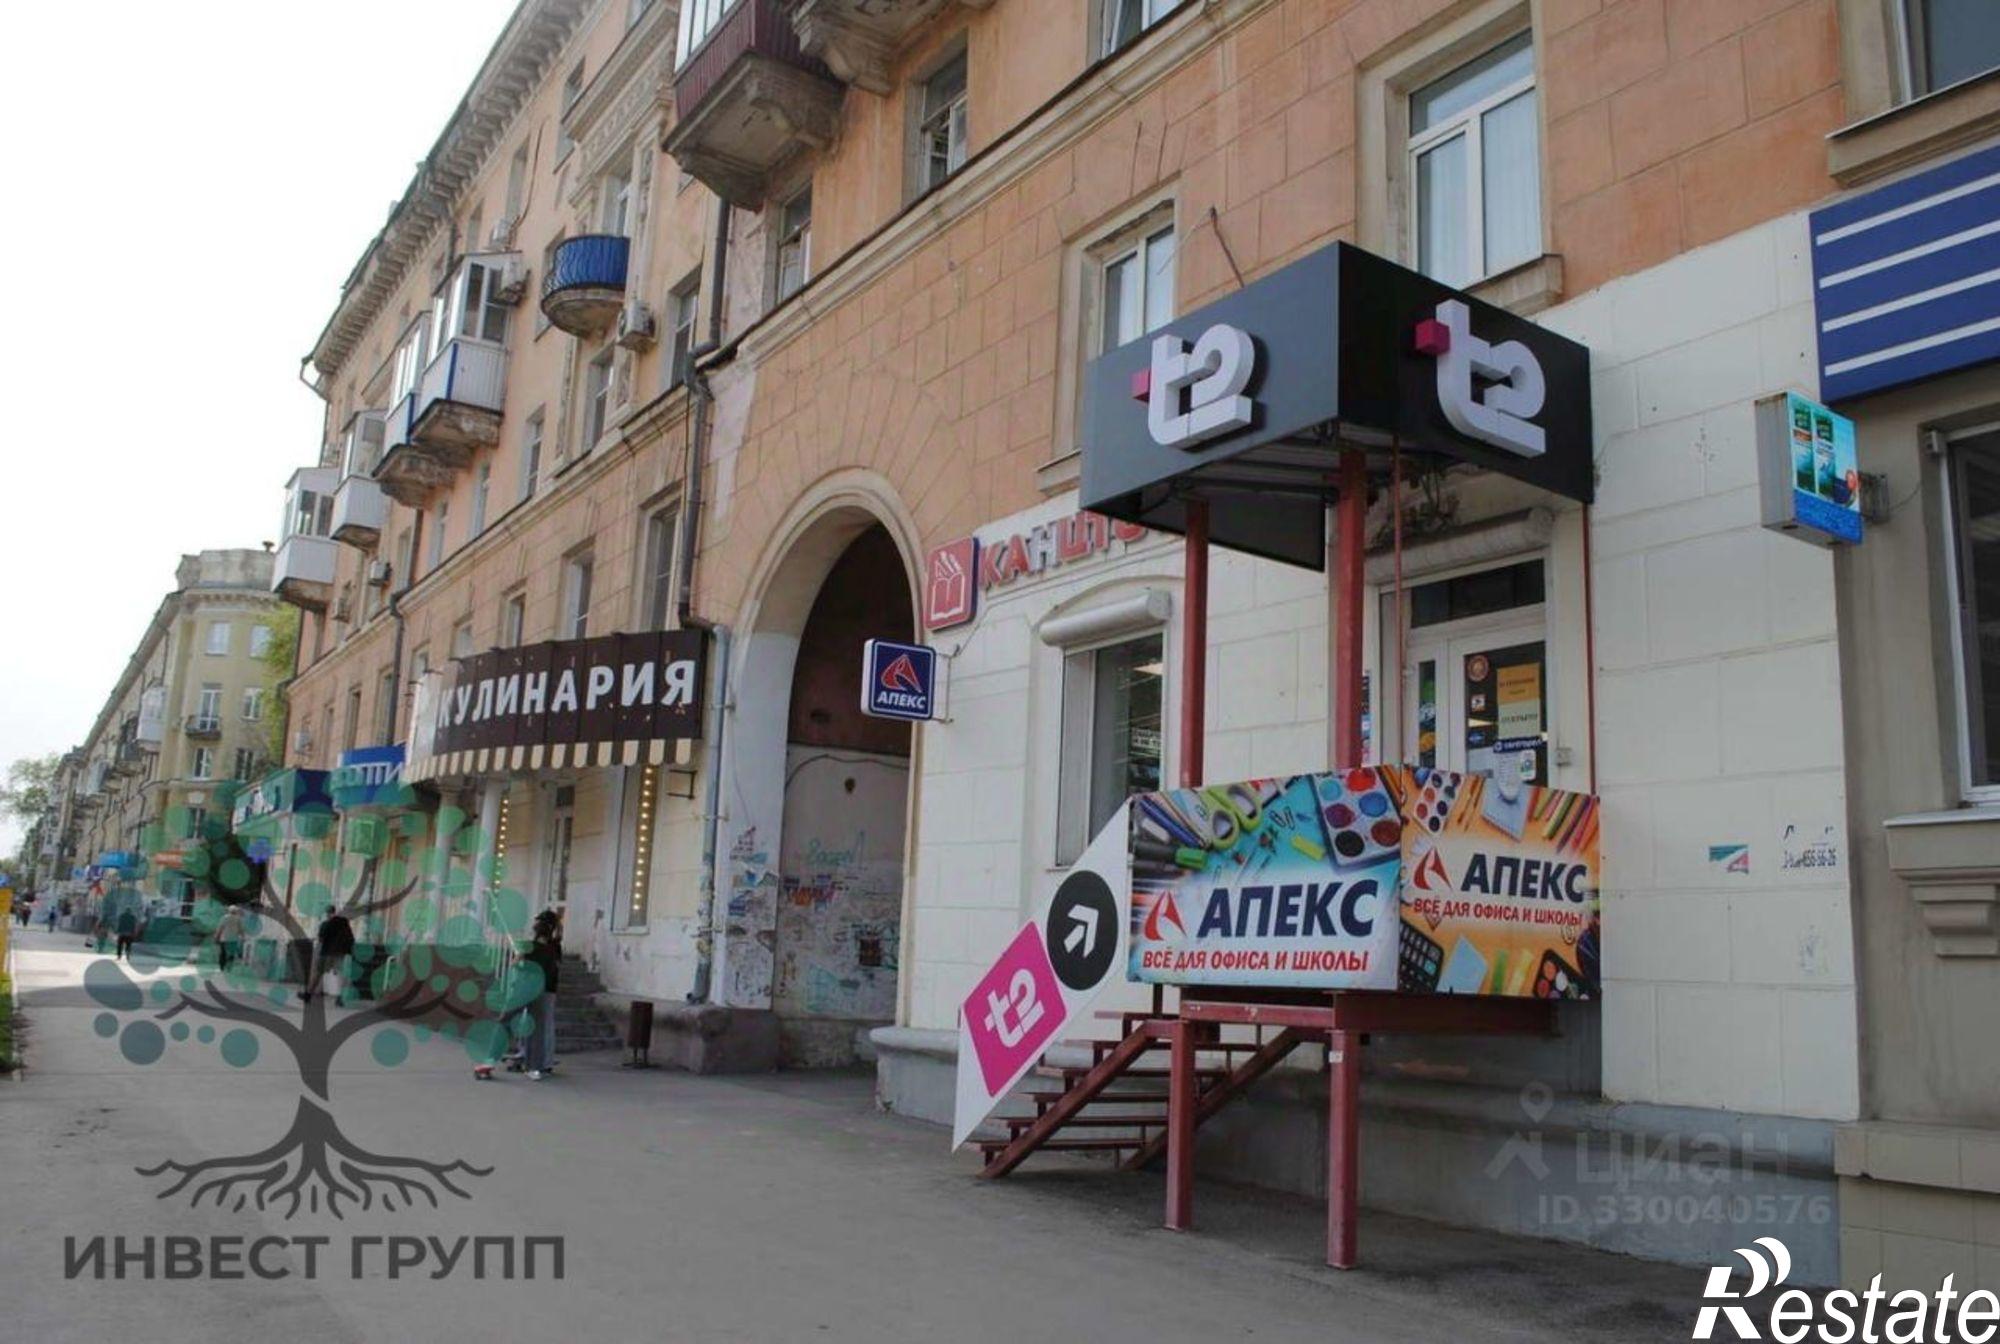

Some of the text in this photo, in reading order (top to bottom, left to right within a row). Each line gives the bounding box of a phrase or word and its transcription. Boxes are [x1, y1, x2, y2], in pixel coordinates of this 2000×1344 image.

[1131, 323, 1255, 447] t2
[1414, 299, 1547, 458] t2
[437, 659, 696, 729] КУЛИНАРИЯ
[877, 690, 926, 709] АПЕКС
[1459, 852, 1588, 904] АПЕКС
[1196, 879, 1379, 938] АПЕКС
[1443, 899, 1470, 917] ДЛЯ
[1473, 902, 1520, 922] ОФИСА
[1523, 906, 1532, 923] И
[1534, 909, 1583, 926] ШКОЛЫ
[1142, 946, 1370, 972] ВСЁ ДЛЯ ОФИСА И ШКОЛЫ
[985, 968, 1045, 1048] t2
